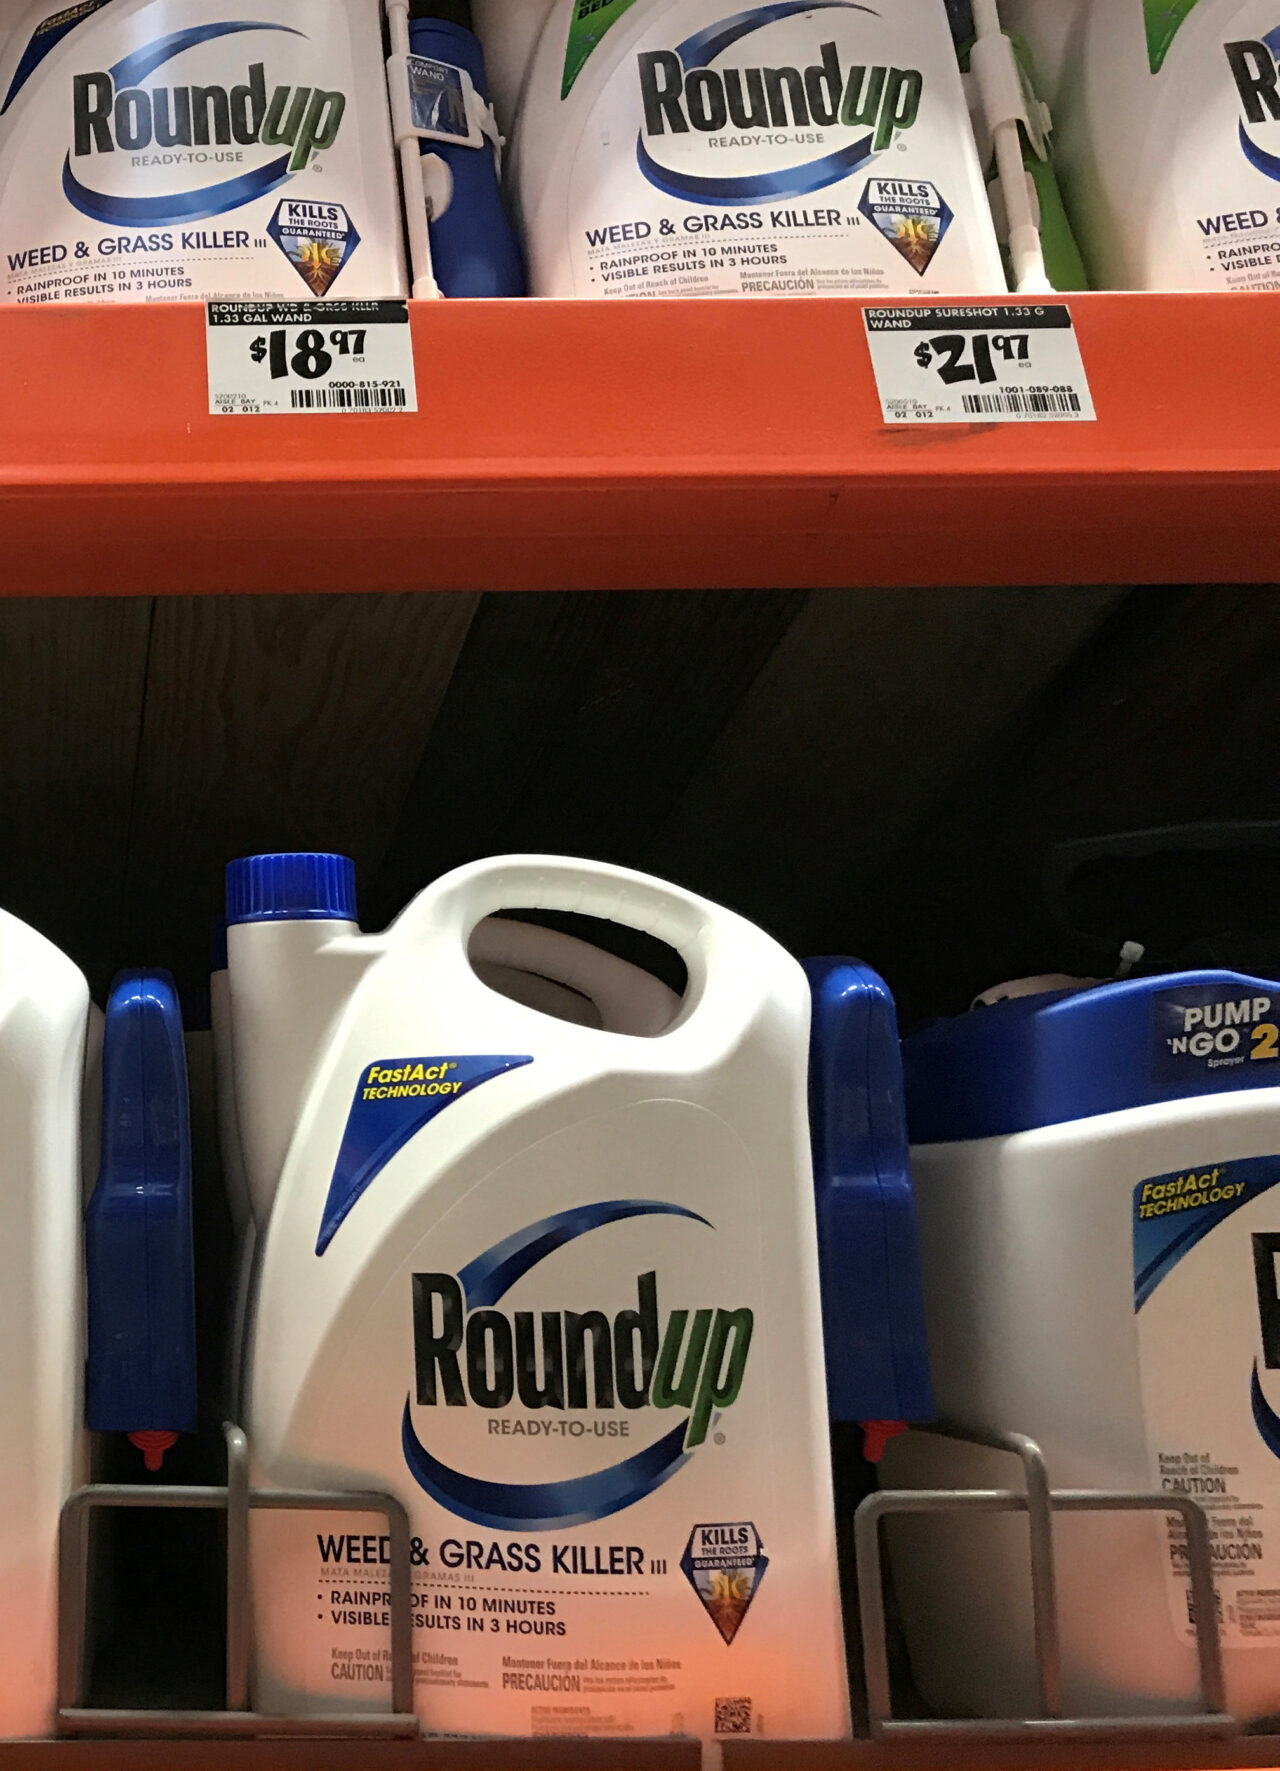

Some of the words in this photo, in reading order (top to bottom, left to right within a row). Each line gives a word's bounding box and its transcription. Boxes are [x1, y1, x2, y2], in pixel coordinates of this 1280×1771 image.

[410, 65, 444, 80] WAND
[637, 42, 923, 154] Roundup
[73, 62, 345, 171] Roundup
[707, 133, 824, 149] READY-TO-USE
[131, 153, 244, 167] READY-TO-USE
[877, 182, 929, 197] KILLS
[288, 204, 338, 220] KILLS
[308, 220, 338, 229] ROOTS
[585, 221, 651, 247] WEED
[659, 219, 675, 236] &
[683, 212, 763, 233] GRASS
[770, 210, 841, 228] KILLER
[1197, 210, 1268, 235] WEED
[282, 228, 342, 239] GUARANTEED
[8, 244, 67, 271] WEED
[74, 241, 90, 259] &
[97, 234, 173, 255] GRASS
[182, 231, 249, 249] KILLER
[212, 315, 239, 323] 1.33
[243, 314, 268, 322] GAL
[272, 314, 312, 322] WAND
[869, 310, 931, 318] ROUNDUP
[936, 309, 998, 317] SURESHOT
[1004, 308, 1030, 316] 1.33
[870, 320, 912, 328] WAND
[1184, 997, 1271, 1032] PUMP
[1250, 1023, 1279, 1060] 2
[1207, 1056, 1245, 1068] Sprayer
[363, 1082, 462, 1100] TECHNOLOGY
[1139, 1182, 1245, 1219] TECHNOLOGY
[411, 1271, 754, 1449] Roundup
[487, 1418, 629, 1437] READY-TO-USE
[1162, 1478, 1226, 1493] CAUTION
[702, 1528, 748, 1545] KILLS
[410, 1537, 429, 1566] &
[440, 1539, 541, 1573] GRASS
[552, 1545, 644, 1574] KILLER
[651, 1560, 667, 1574] III
